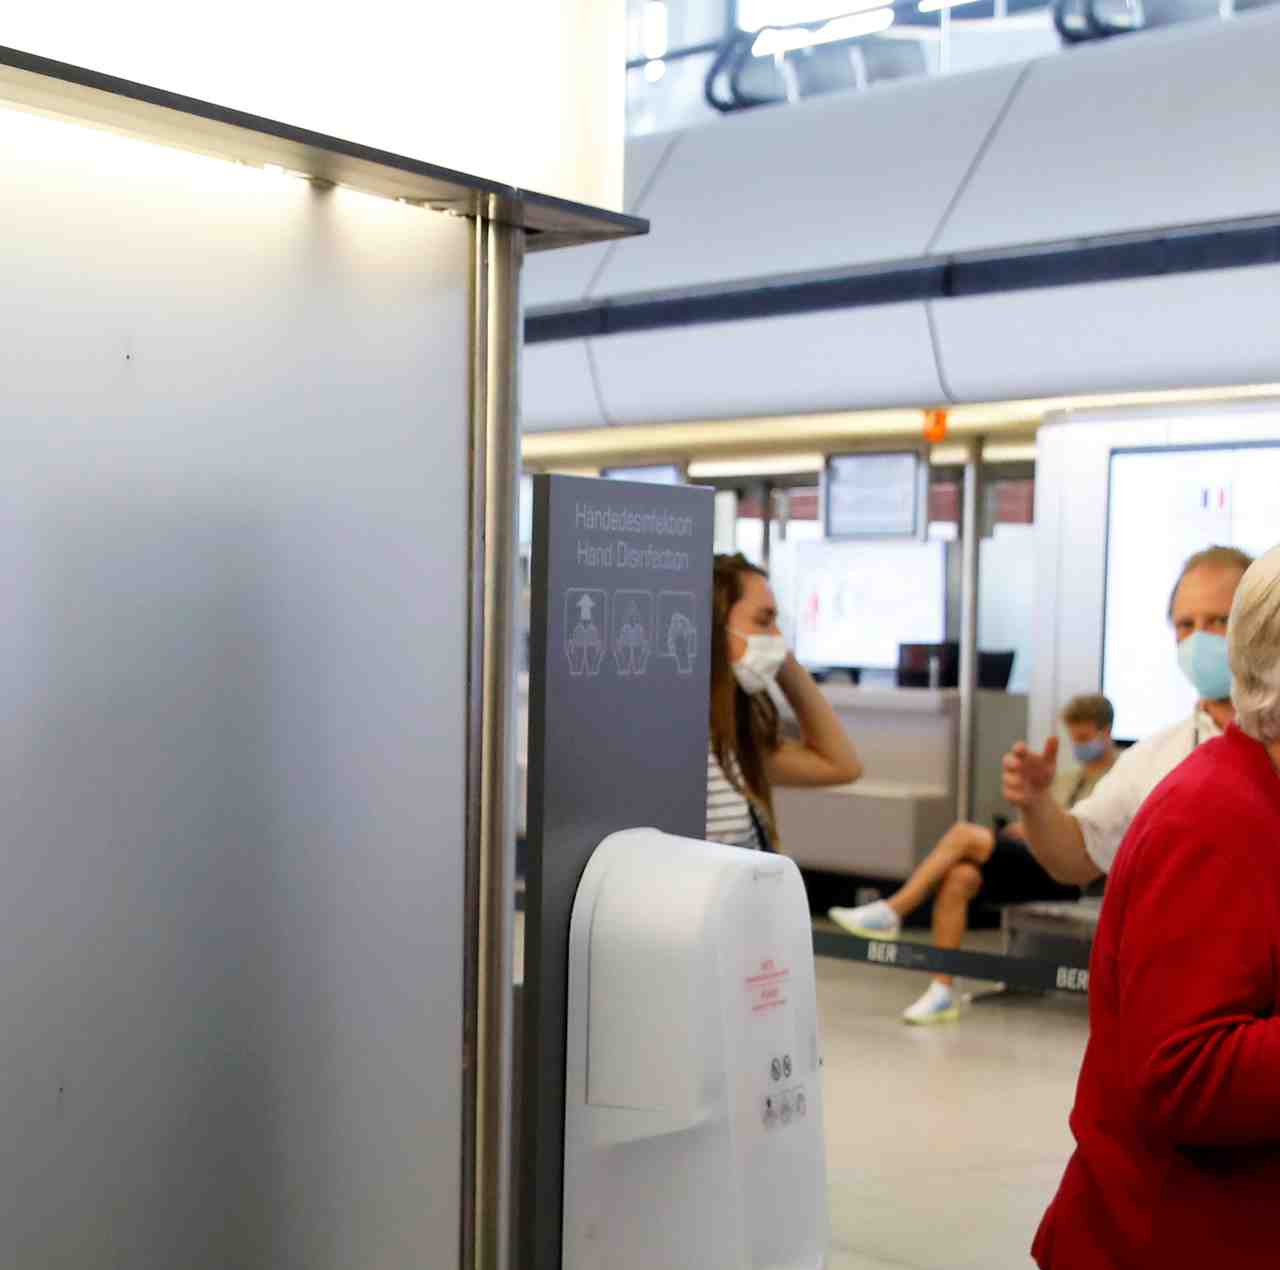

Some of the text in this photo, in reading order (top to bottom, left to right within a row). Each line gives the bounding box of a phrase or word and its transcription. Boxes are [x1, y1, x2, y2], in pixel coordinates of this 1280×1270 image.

[576, 540, 689, 570] Hand Disinfection
[867, 941, 897, 963] BER
[1056, 966, 1089, 992] BER
